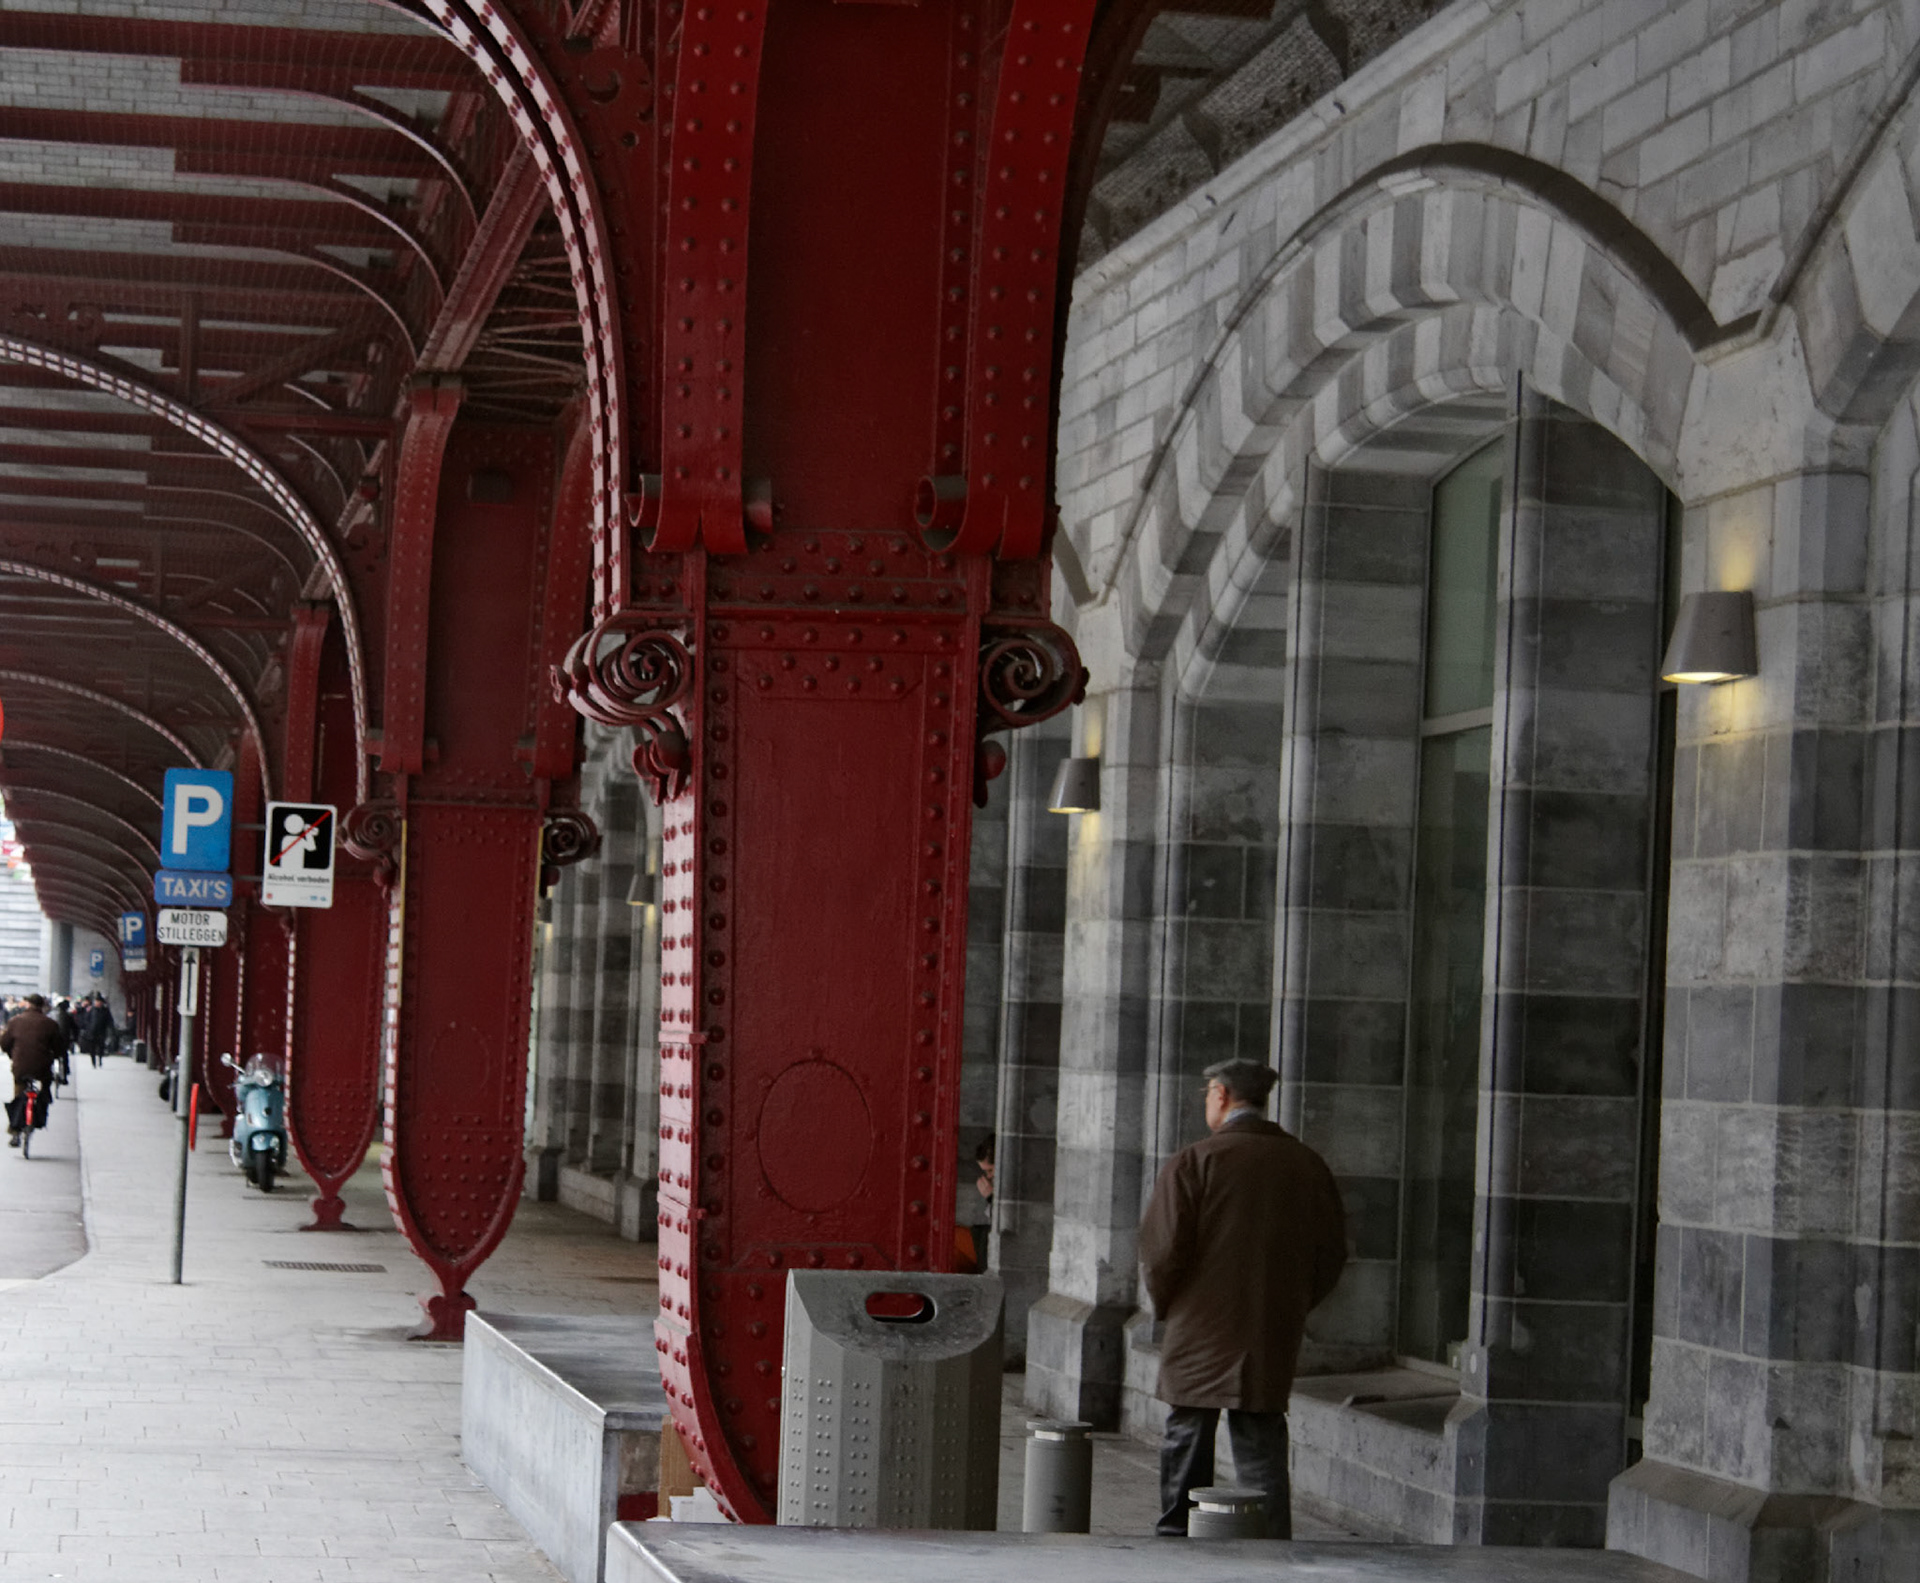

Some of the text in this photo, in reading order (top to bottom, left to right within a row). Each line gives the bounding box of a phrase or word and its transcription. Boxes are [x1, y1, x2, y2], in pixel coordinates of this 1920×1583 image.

[172, 784, 224, 855] P
[297, 876, 330, 884] verboden
[161, 877, 228, 900] TAXI'S
[170, 912, 211, 926] MOTOR
[125, 917, 143, 942] P
[157, 926, 226, 942] STILLEGGEN
[91, 952, 103, 968] P
